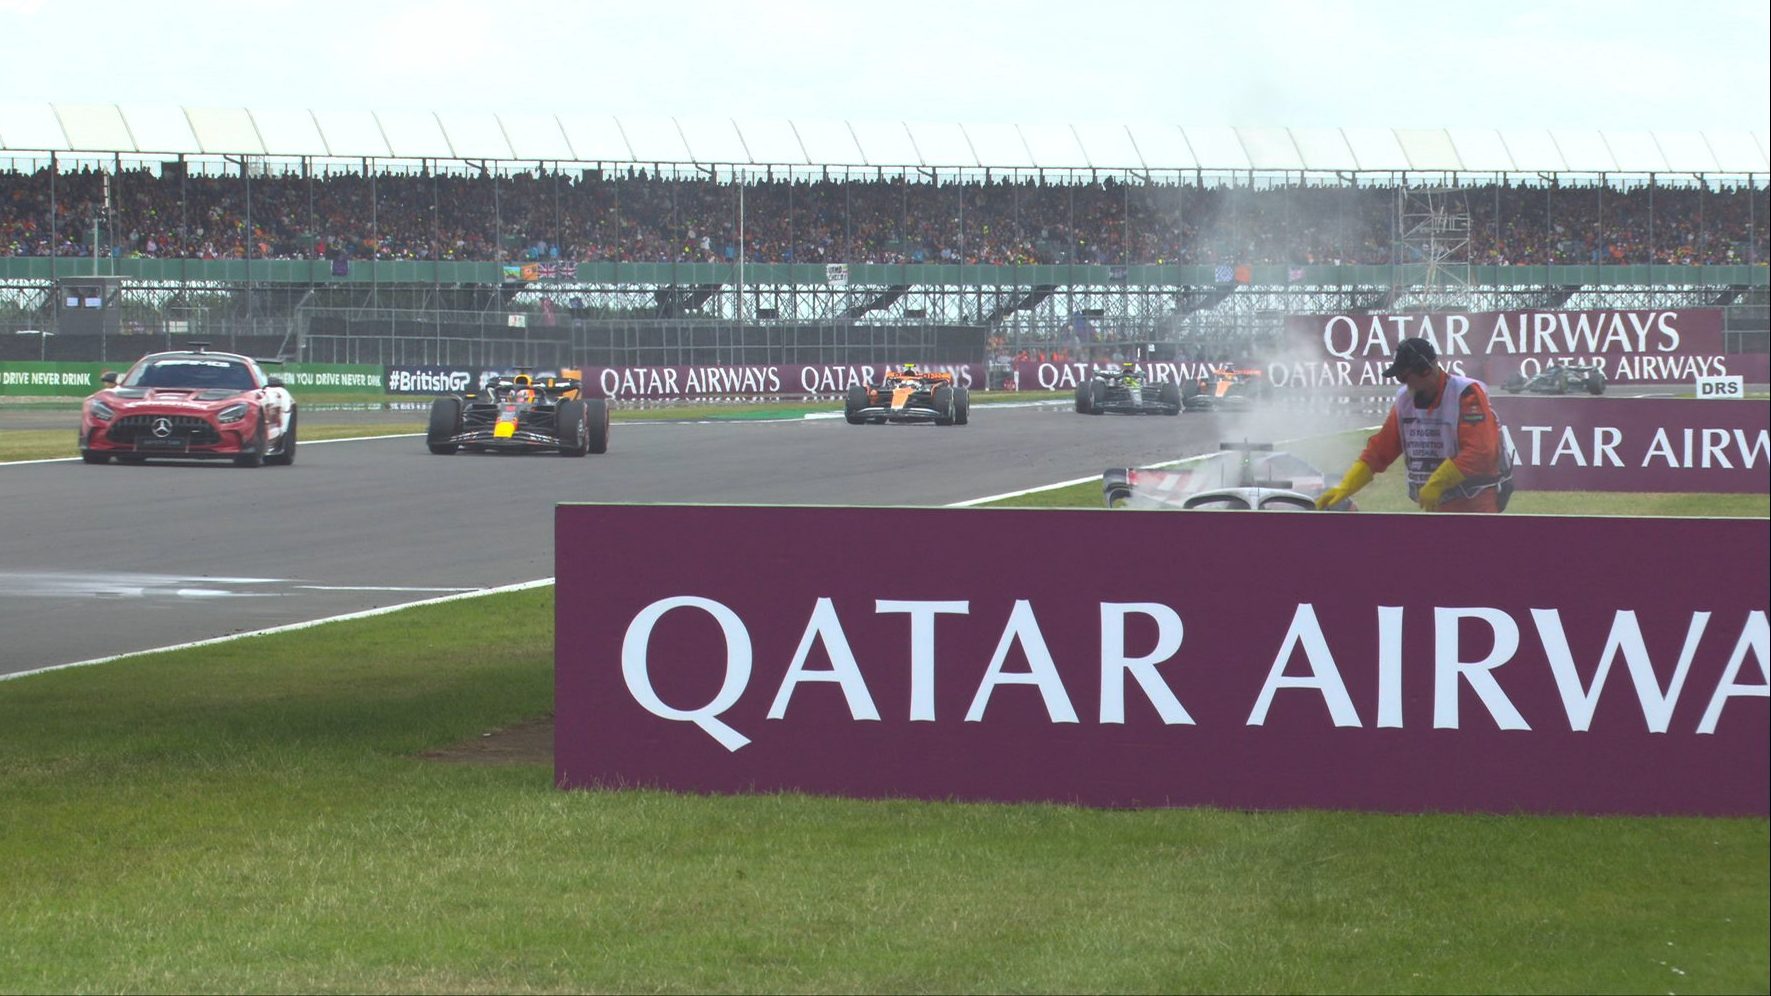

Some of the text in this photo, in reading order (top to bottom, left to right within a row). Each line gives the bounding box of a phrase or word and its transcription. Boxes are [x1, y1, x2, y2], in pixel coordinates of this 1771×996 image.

[1323, 313, 1681, 360] QATAR AIRWAYS
[3, 372, 91, 386] DRIVE NEVER DRINK
[297, 373, 314, 385] YOU
[316, 373, 340, 385] DRIVE
[341, 374, 366, 386] NEVER
[1134, 363, 1236, 387] IRWAY
[1360, 360, 1466, 385] AIRYS
[1615, 356, 1727, 379] AIRWAYS
[389, 371, 470, 391] #BritishGP
[601, 367, 781, 399] QATAR AIRWAYS
[801, 366, 876, 394] QATAR
[1702, 382, 1738, 394] DRS
[1501, 424, 1770, 469] ATAR AIRW
[621, 595, 1197, 752] QATAR
